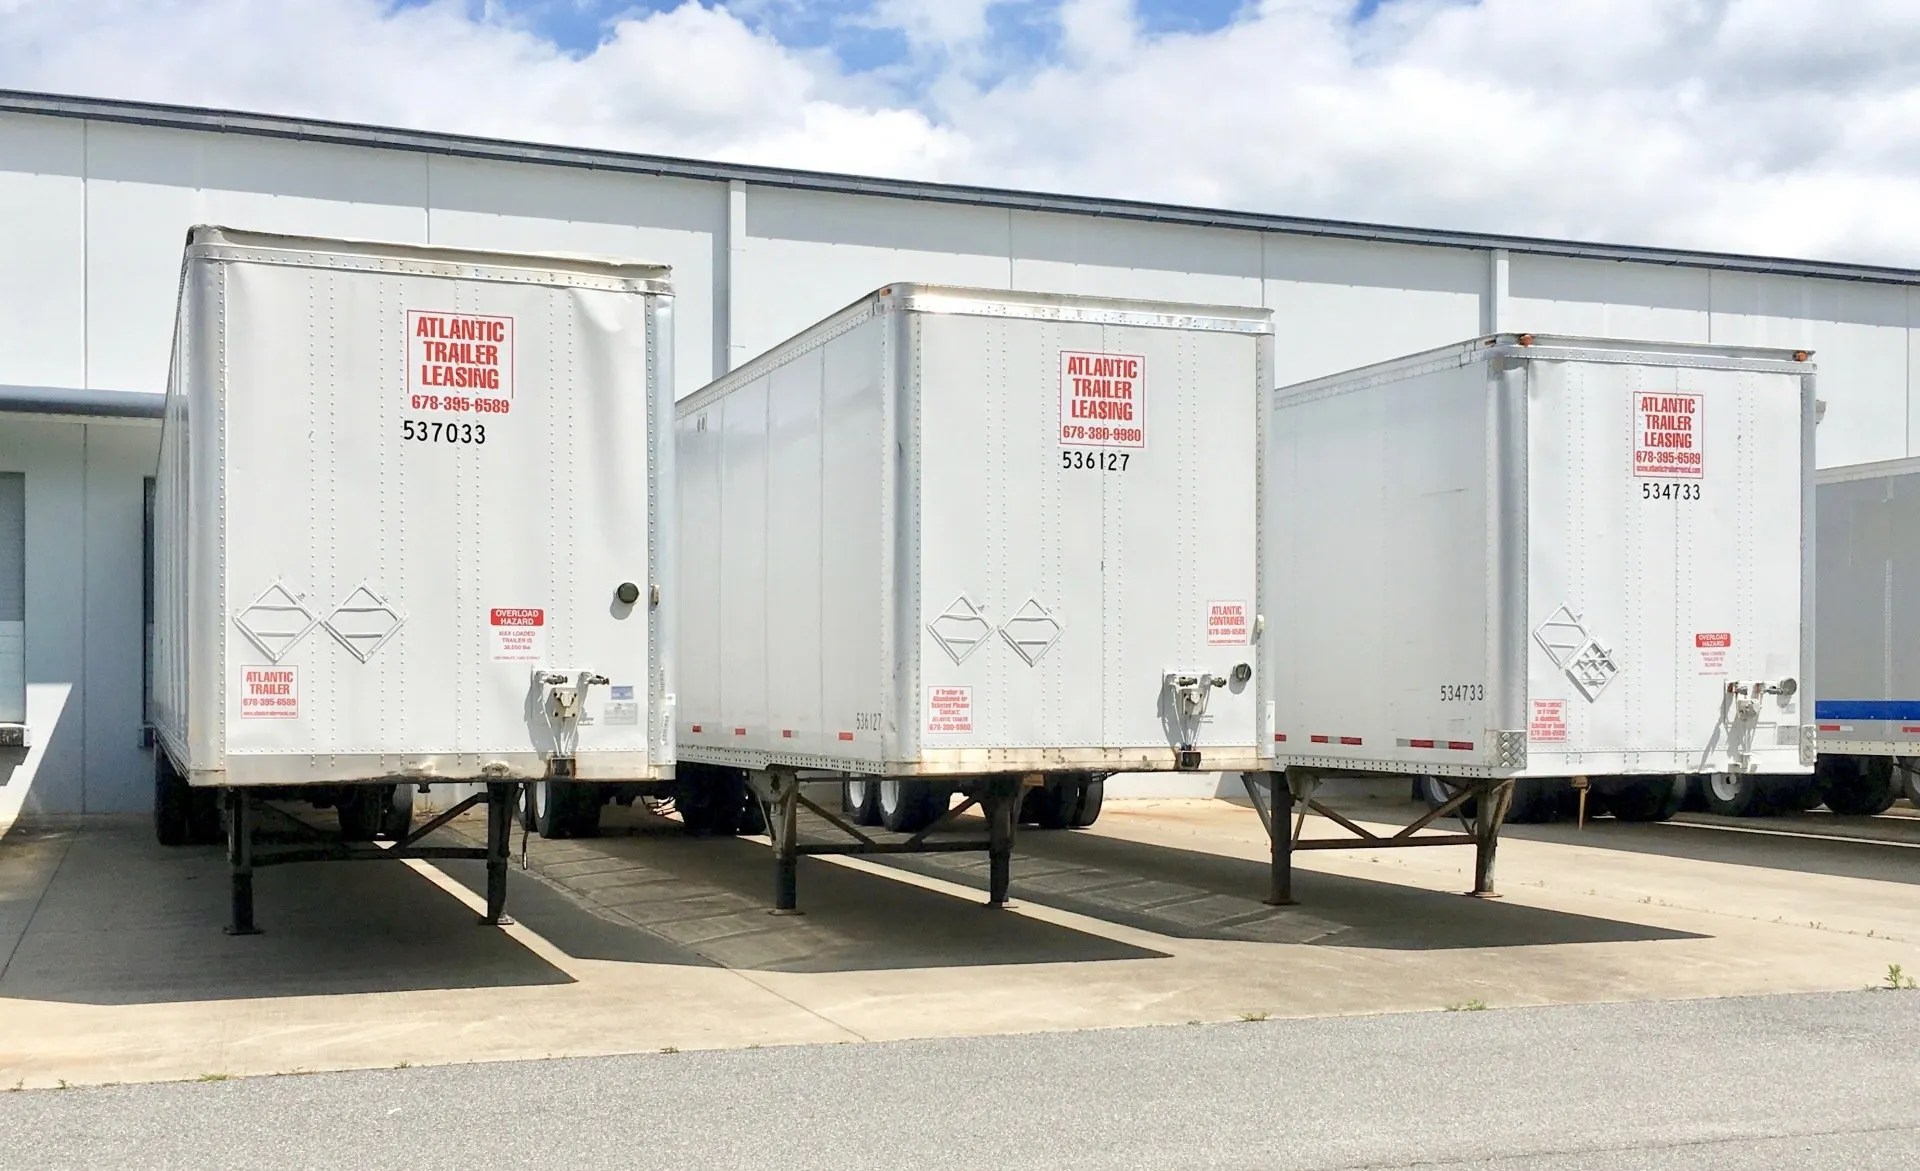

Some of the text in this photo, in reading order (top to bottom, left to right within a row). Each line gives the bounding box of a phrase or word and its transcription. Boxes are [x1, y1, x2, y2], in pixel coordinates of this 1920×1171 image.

[416, 316, 504, 342] ATLANTIC
[423, 341, 498, 365] TRAILER
[1068, 356, 1137, 379] ATLANTIC
[422, 365, 499, 389] LEASING
[1072, 378, 1132, 399] TRAILER
[412, 394, 510, 414] 678-395-6589
[1071, 399, 1133, 421] LEASING
[1641, 396, 1696, 414] ATLANTIC
[1645, 414, 1692, 431] TRAILER
[403, 420, 486, 444] 537033
[1063, 425, 1141, 442] 678-380-9980
[1644, 431, 1692, 448] LEASING
[1062, 451, 1130, 471] 536127
[1636, 450, 1701, 465] 678-395-6589
[1643, 483, 1701, 500] 534733
[495, 609, 539, 617] OVERLOAD
[1211, 605, 1242, 616] ATLANTIC
[500, 617, 534, 625] HAZARD
[1209, 616, 1245, 626] CONTAINER
[246, 671, 294, 683] ATLANTIC
[250, 683, 290, 695] TRAILER
[1440, 684, 1484, 701] 534733
[856, 712, 882, 731] 536127
